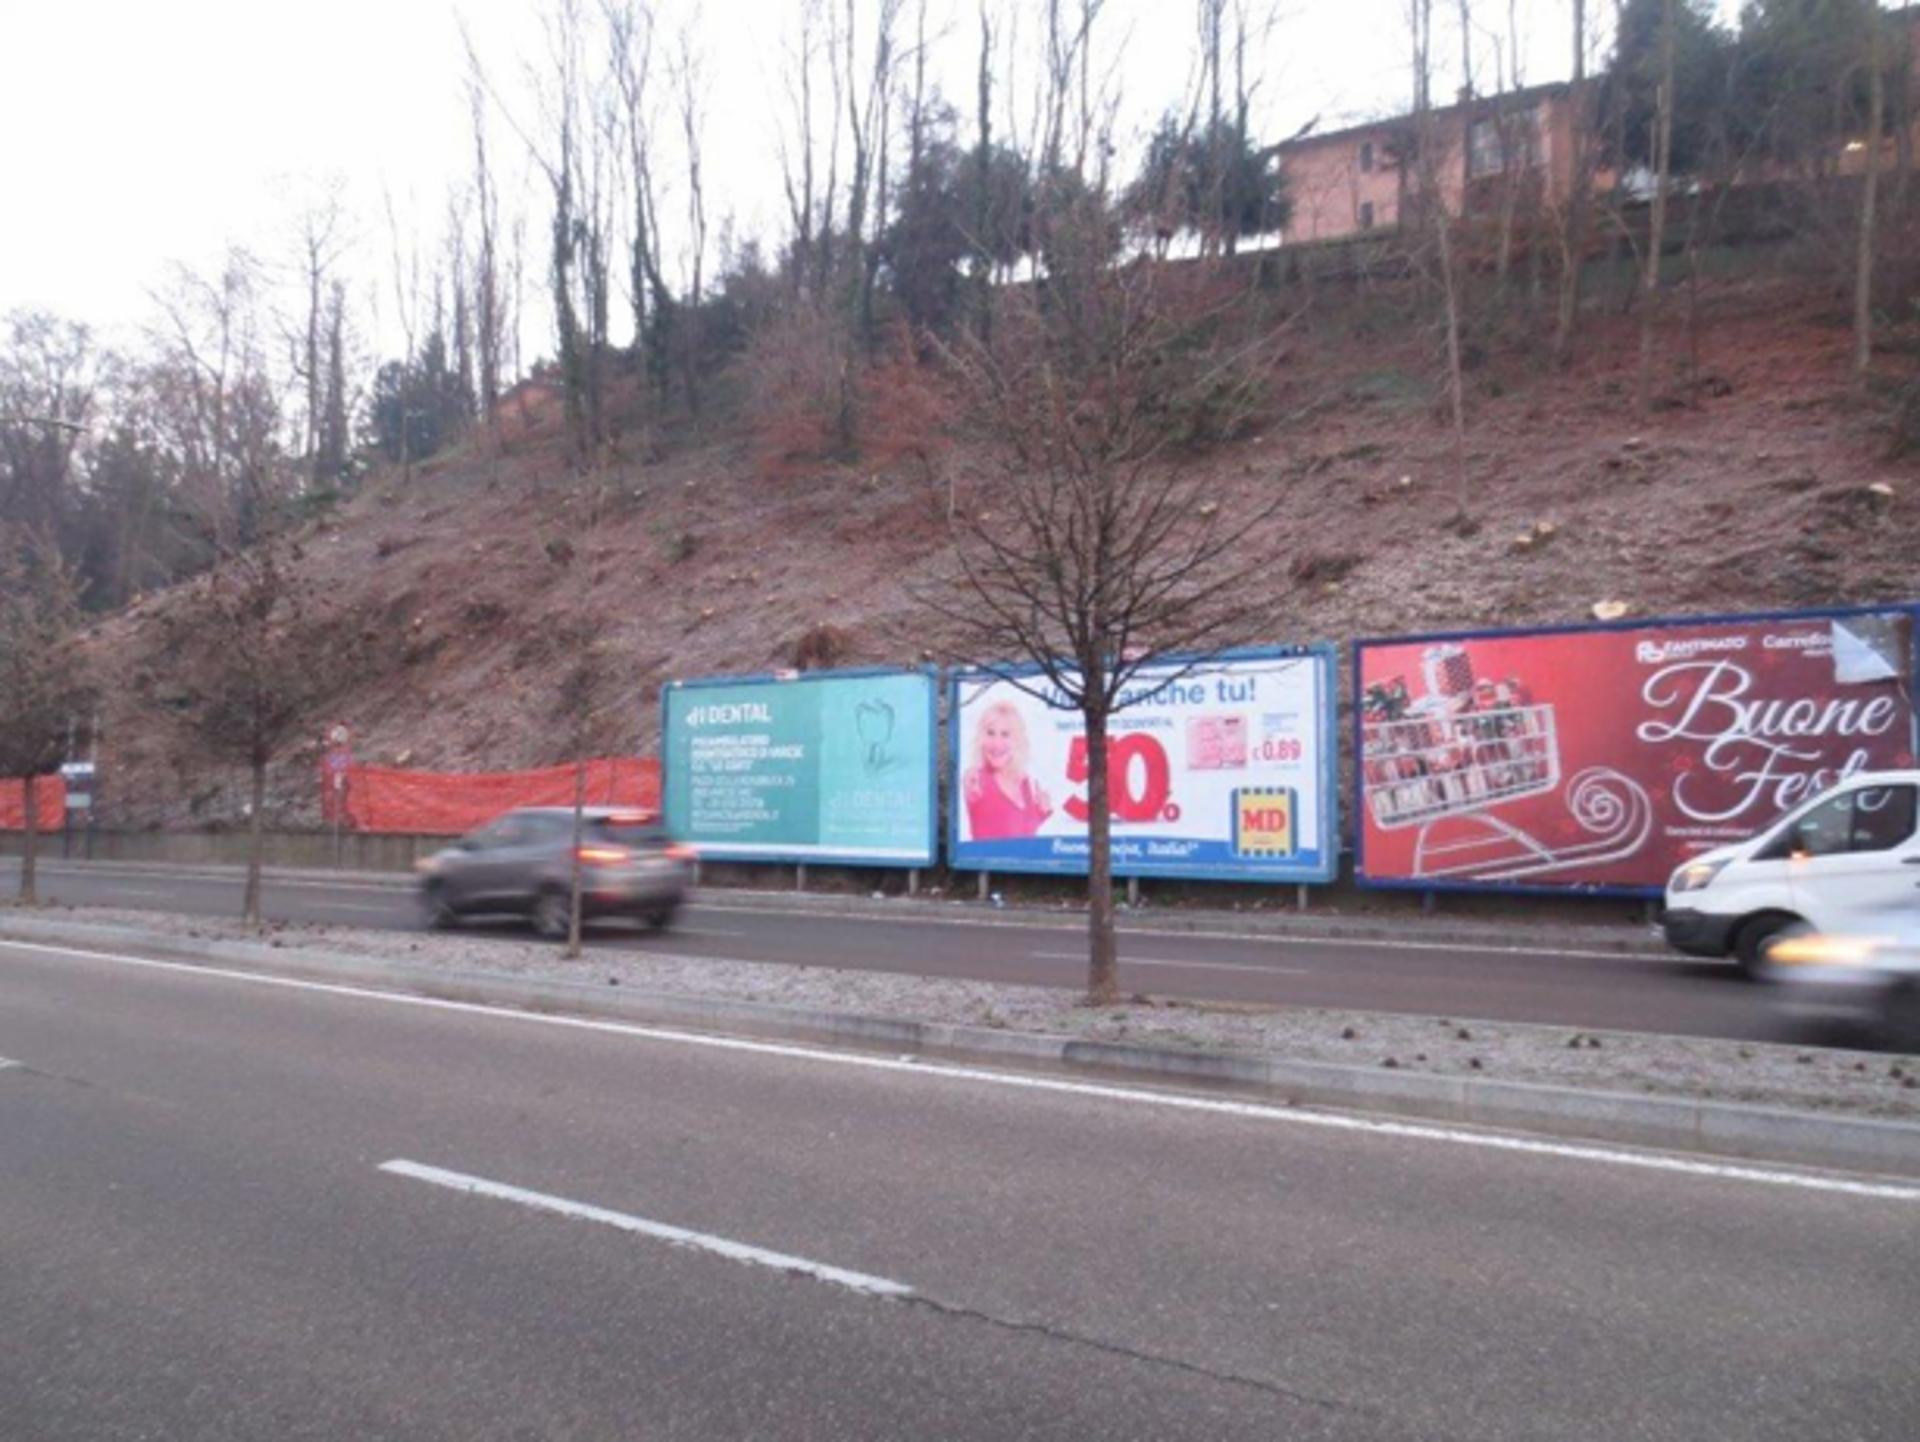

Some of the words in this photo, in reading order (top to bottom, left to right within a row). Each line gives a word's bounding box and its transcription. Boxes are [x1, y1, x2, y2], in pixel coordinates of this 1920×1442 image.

[1762, 632, 1833, 649] Carrefo
[1120, 681, 1205, 705] anche
[1217, 678, 1256, 702] tu!
[1636, 658, 1896, 742] Buone
[708, 702, 772, 723] DENTAL
[1242, 808, 1286, 833] MD
